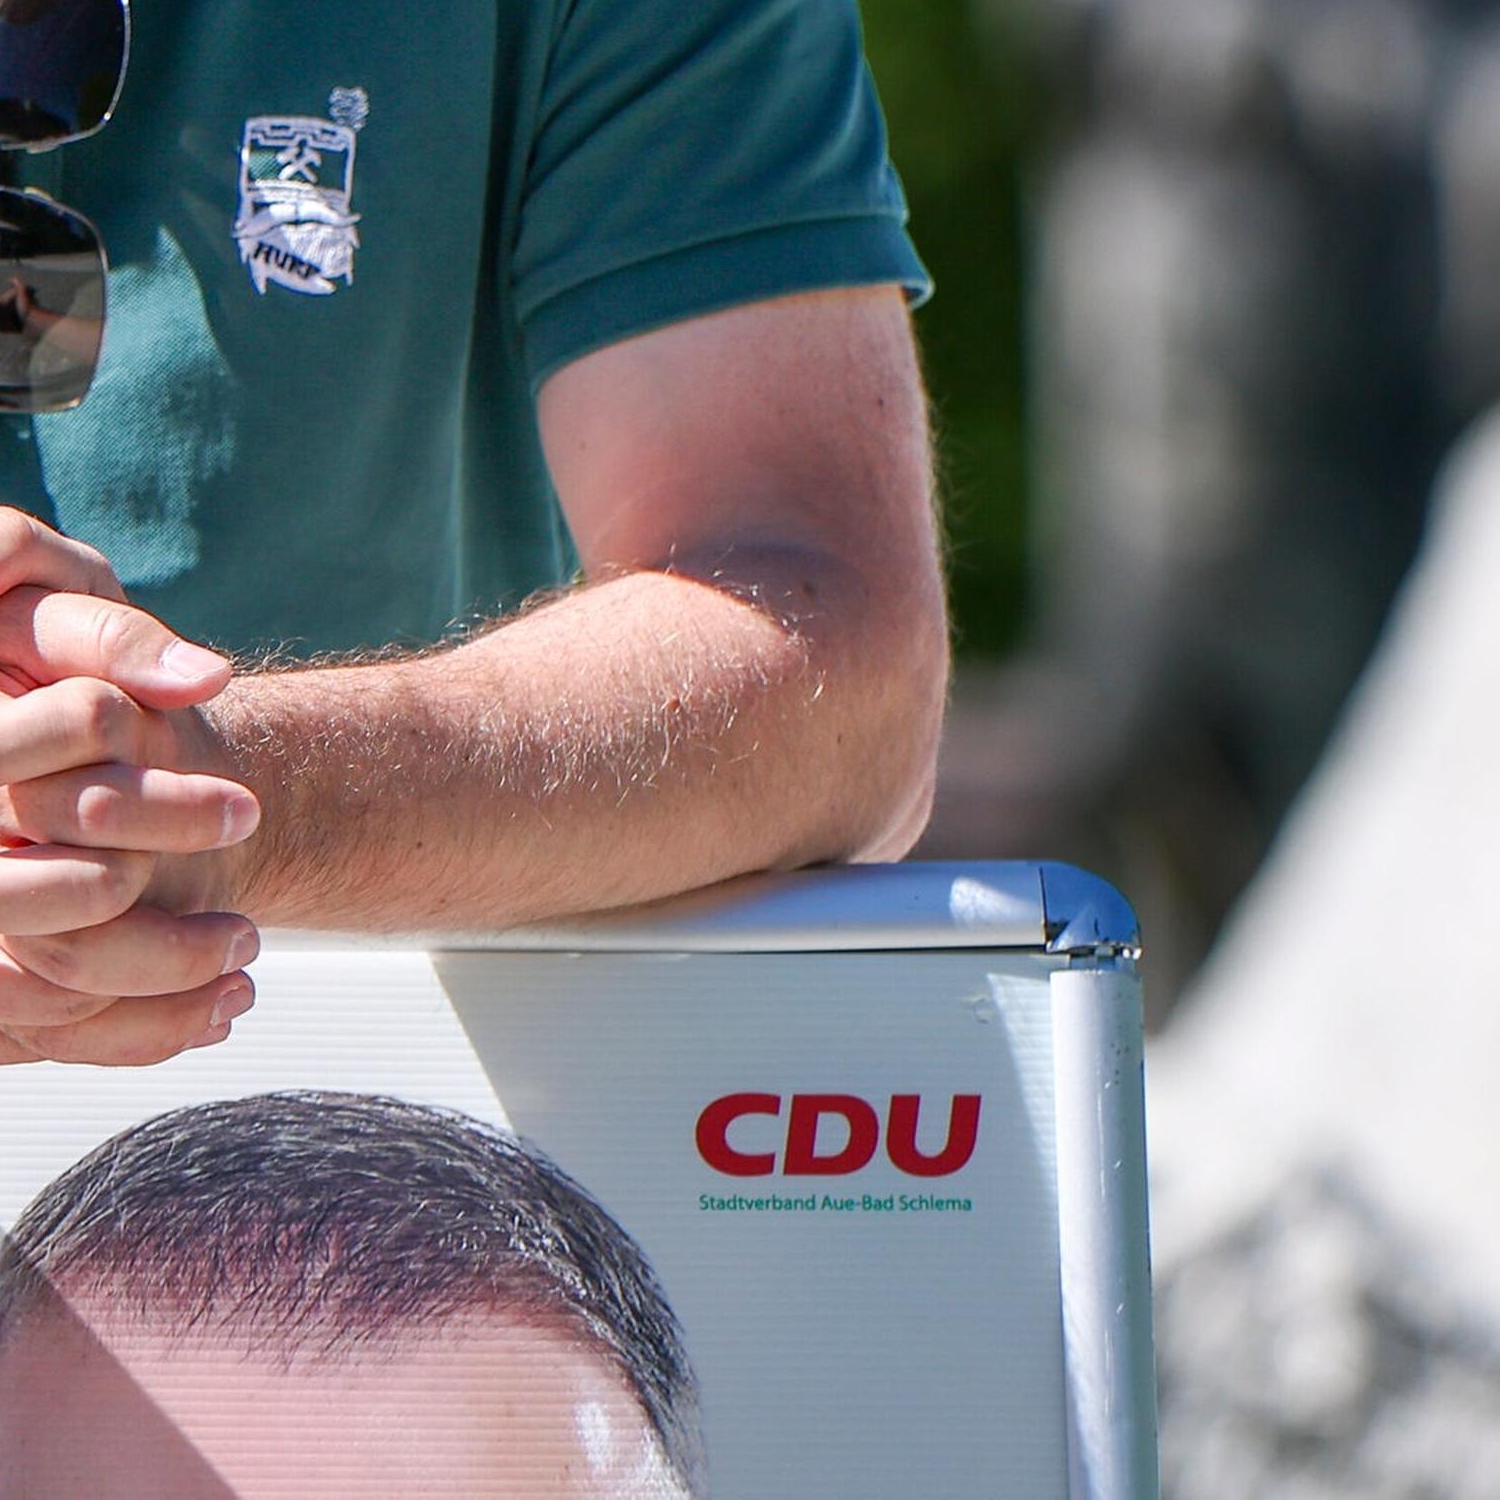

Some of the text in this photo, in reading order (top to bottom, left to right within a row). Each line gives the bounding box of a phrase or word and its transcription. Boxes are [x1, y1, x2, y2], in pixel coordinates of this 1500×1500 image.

[694, 1091, 982, 1178] CDU
[699, 1194, 973, 1212] Stadtverband Aue-Bad Schlema
